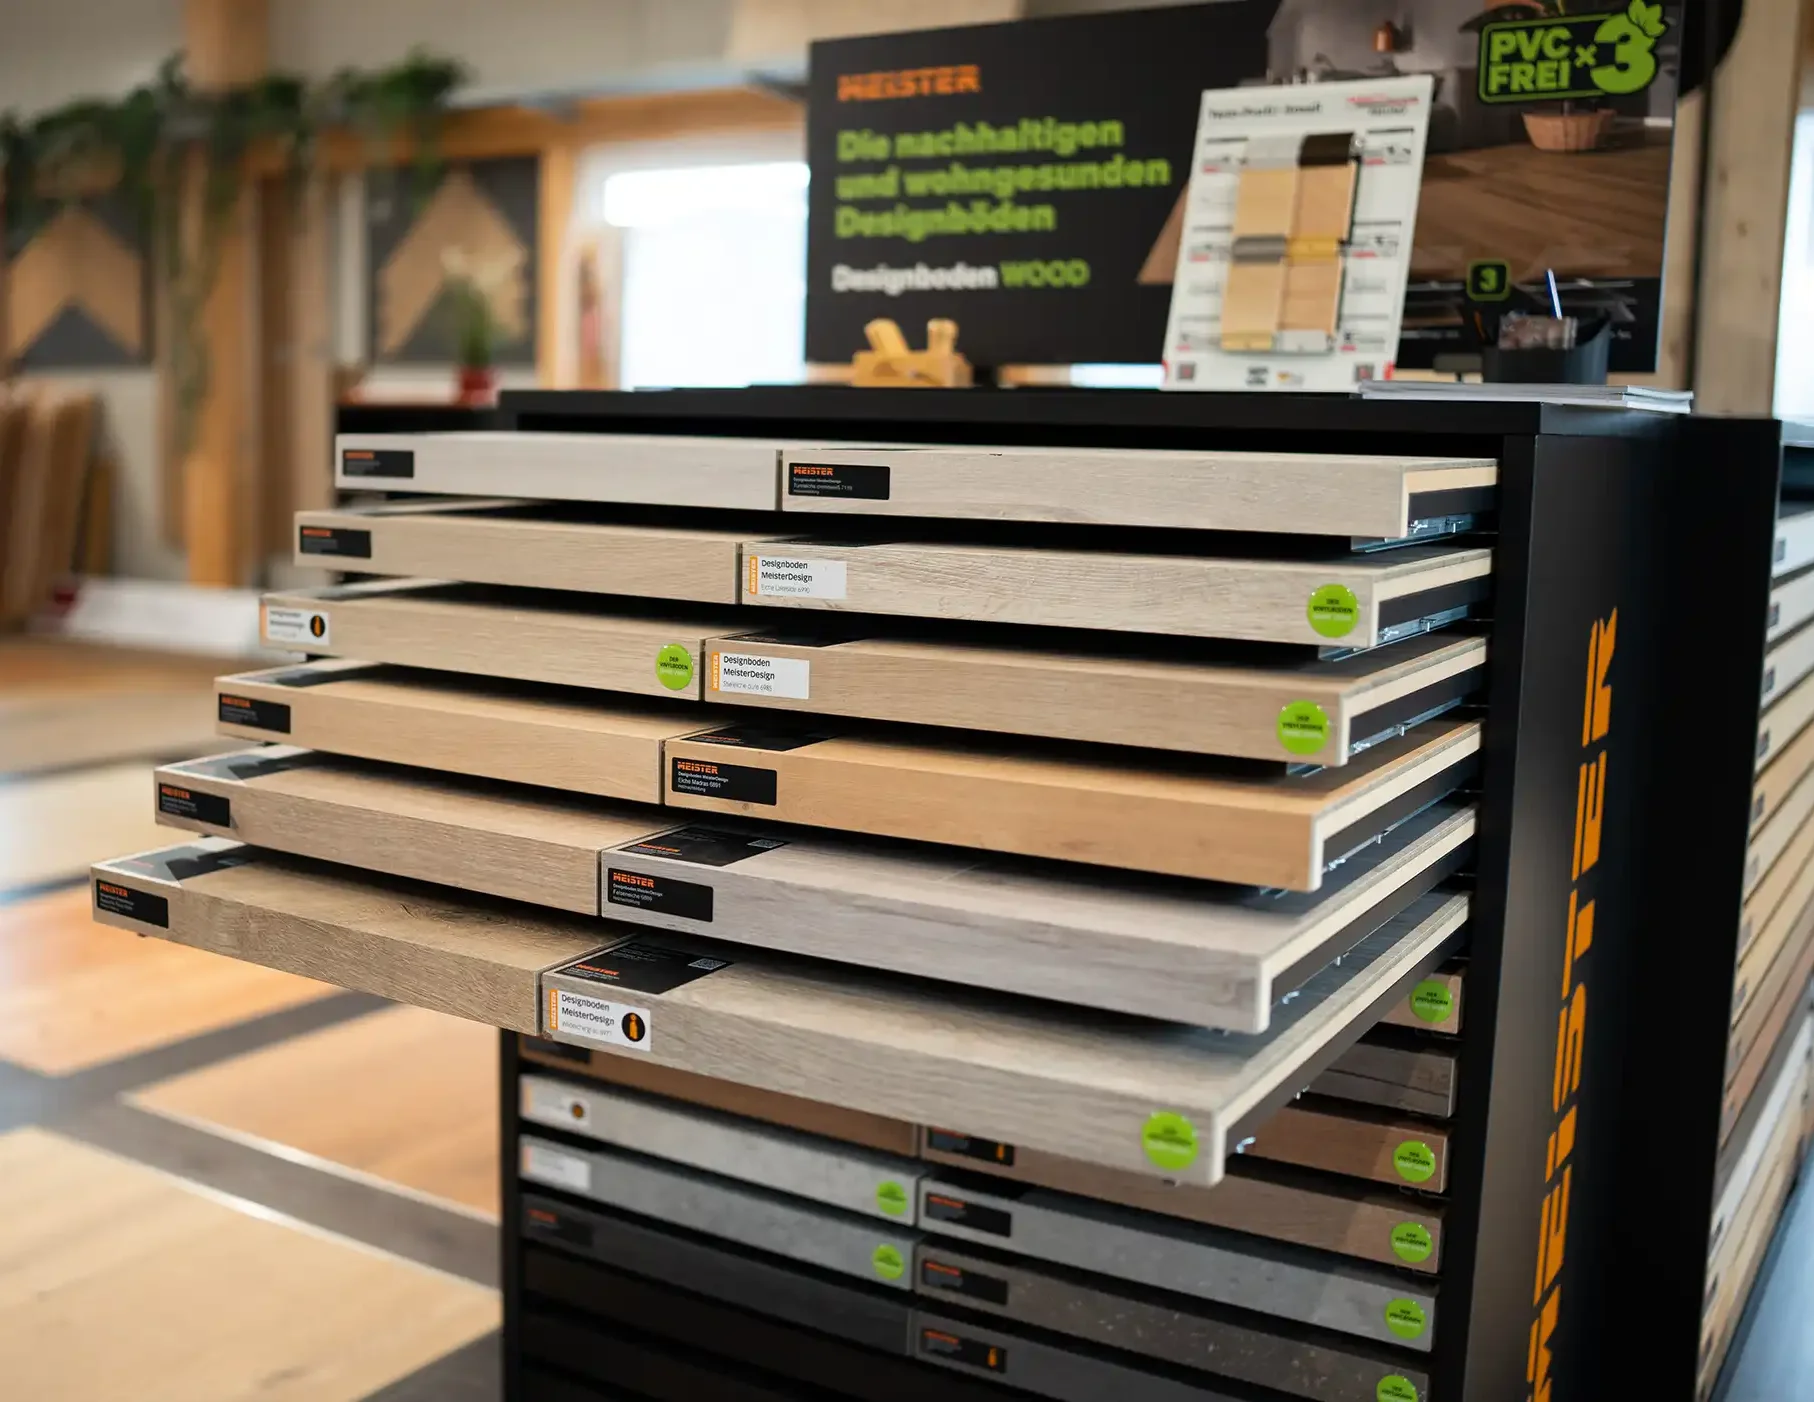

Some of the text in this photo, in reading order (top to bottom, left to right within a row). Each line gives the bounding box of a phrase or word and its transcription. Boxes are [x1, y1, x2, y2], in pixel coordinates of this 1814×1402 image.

[1490, 27, 1572, 61] PVC
[1590, 12, 1656, 94] 3
[837, 64, 981, 101] MEISTER
[1488, 60, 1570, 93] FREI
[836, 118, 1124, 161] Die nachhaltigen
[836, 155, 1171, 199] und wohngesunden
[835, 202, 1056, 242] Designböden
[832, 264, 997, 295] Designboden
[793, 466, 834, 476] MEISTER
[761, 559, 808, 569] Designboden
[761, 571, 813, 583] MeisterDesign
[723, 655, 770, 667] Designboden
[723, 668, 775, 681] MeisterDesign
[677, 761, 718, 775] MEISTER
[613, 872, 655, 888] MEISTER
[561, 994, 610, 1012] Designboden
[1527, 606, 1617, 1402] MEISTER
[561, 1007, 615, 1026] MeisterDesign
